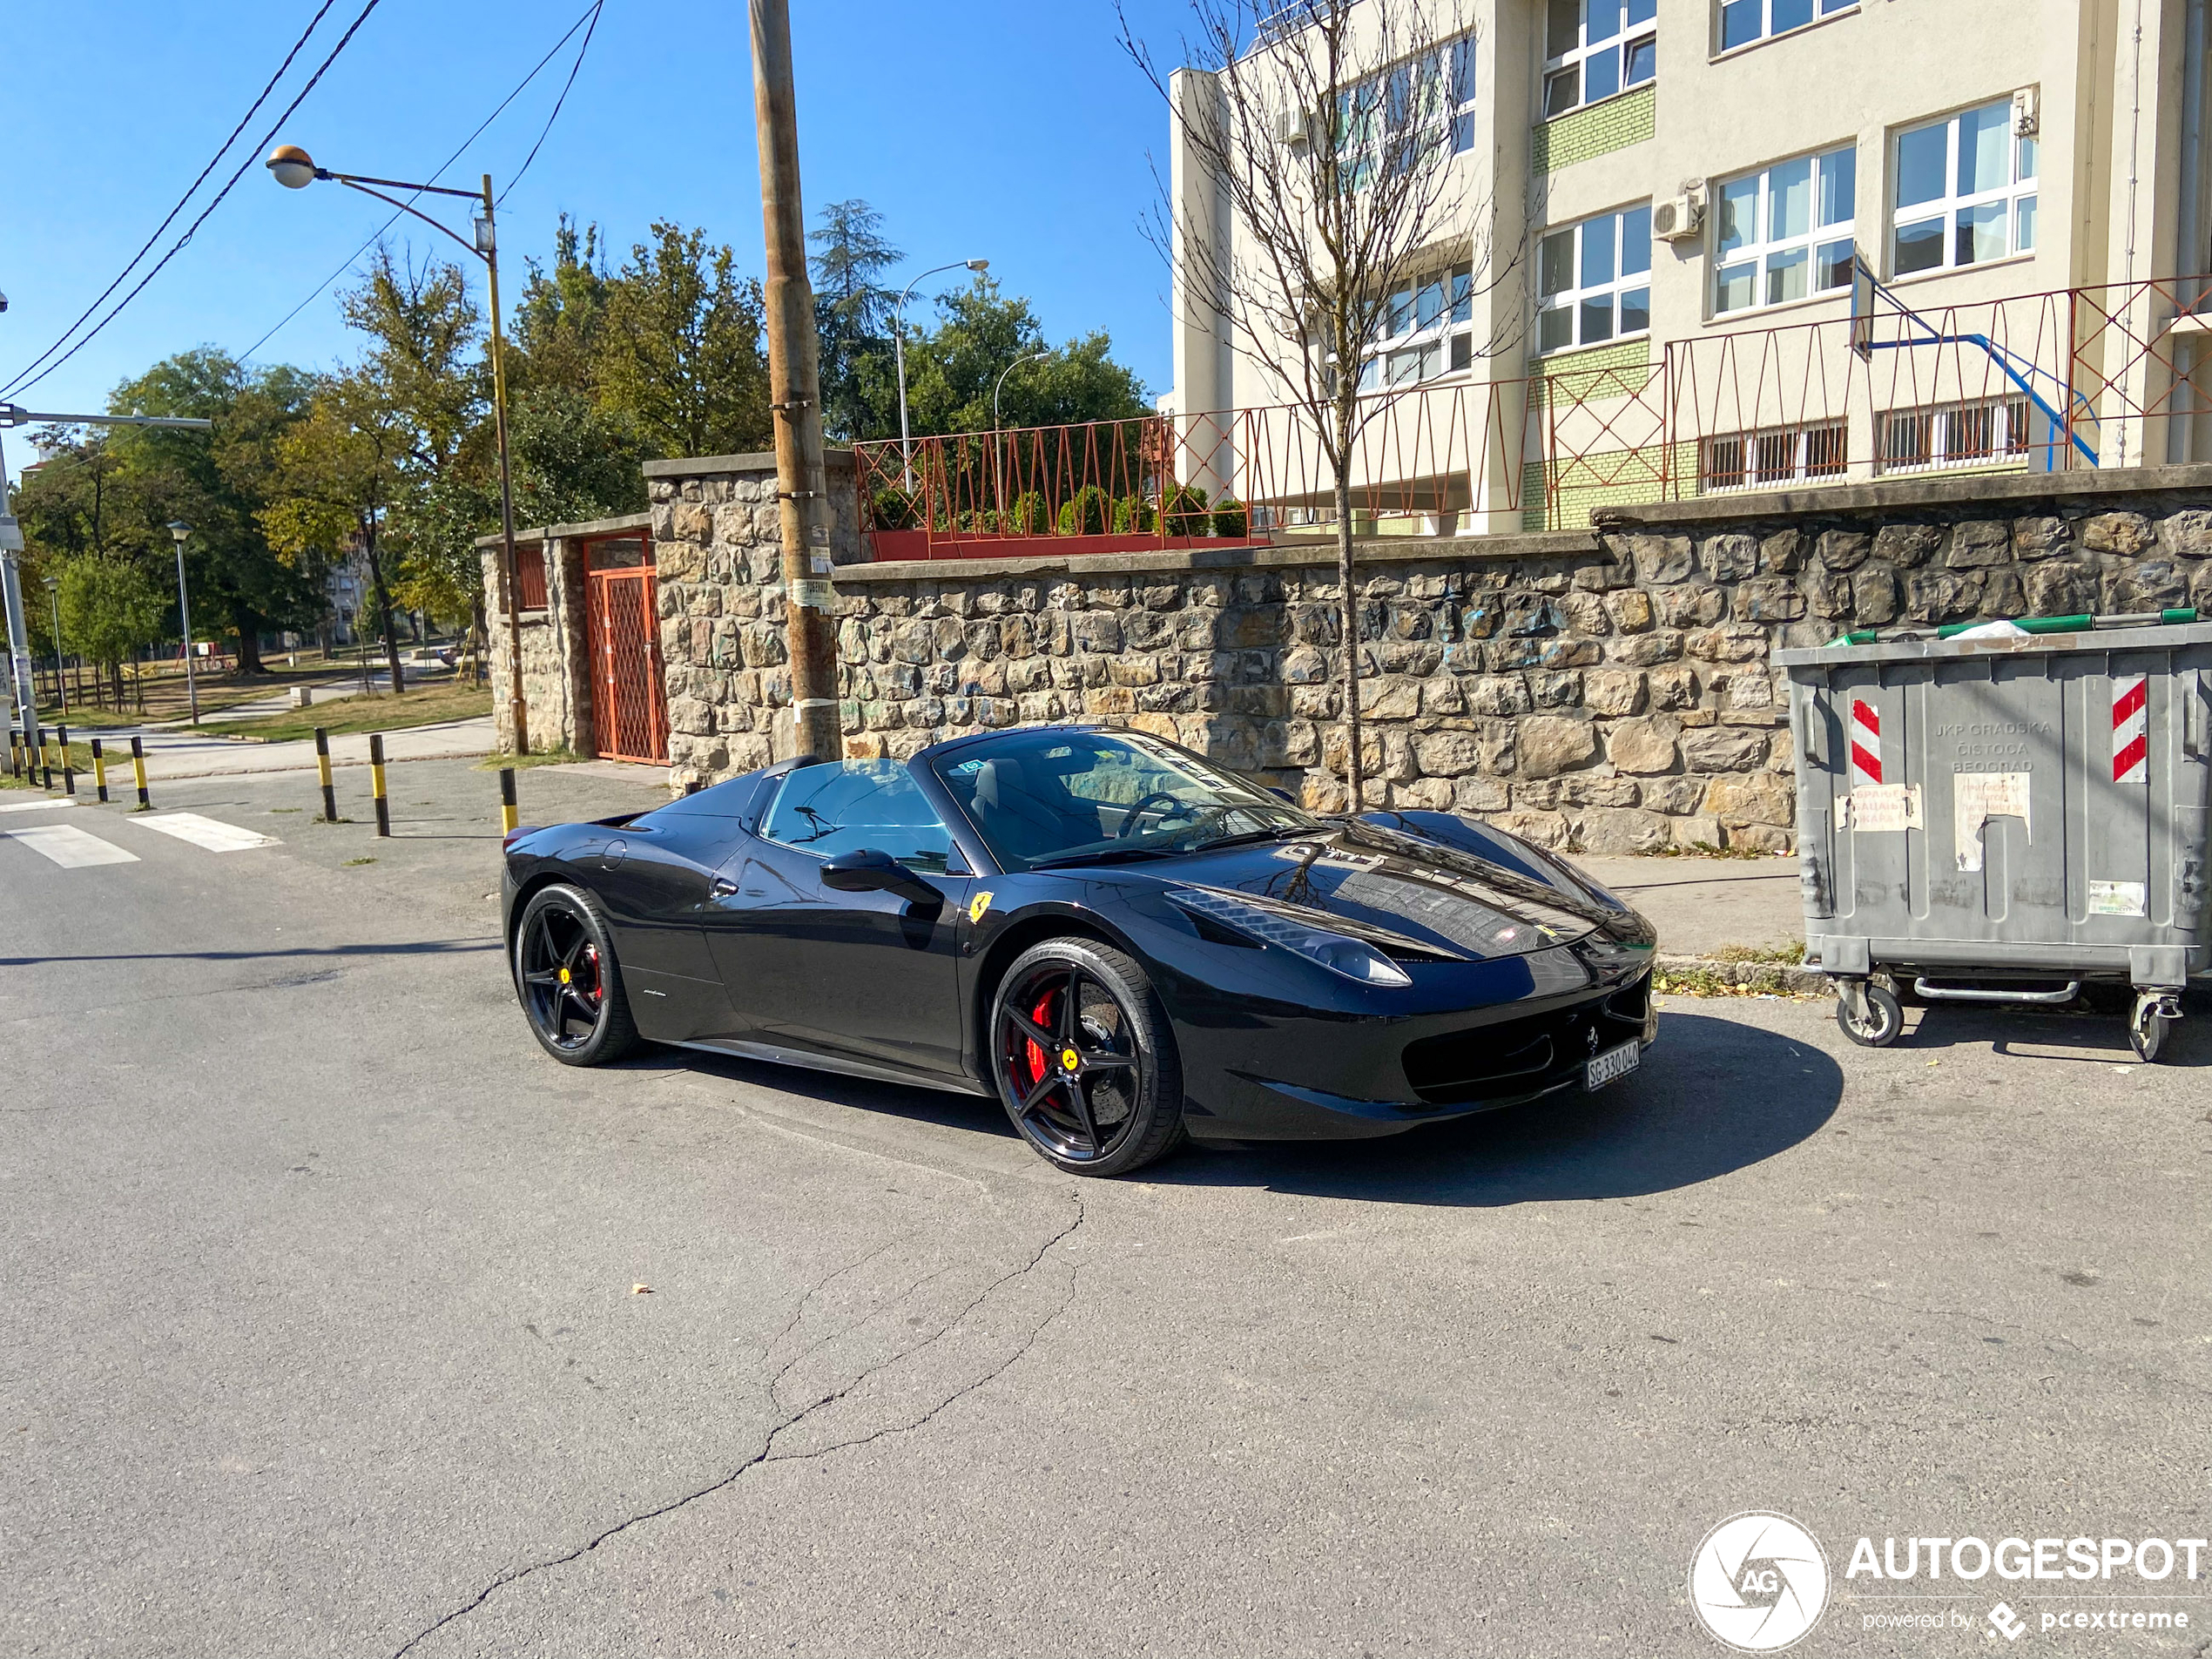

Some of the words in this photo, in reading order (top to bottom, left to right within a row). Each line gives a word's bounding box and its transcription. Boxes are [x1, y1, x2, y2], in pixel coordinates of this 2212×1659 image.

[1936, 724, 1964, 737] JKP
[1969, 721, 2052, 736] GRADSKA
[1952, 760, 2033, 773] BEOGRAD
